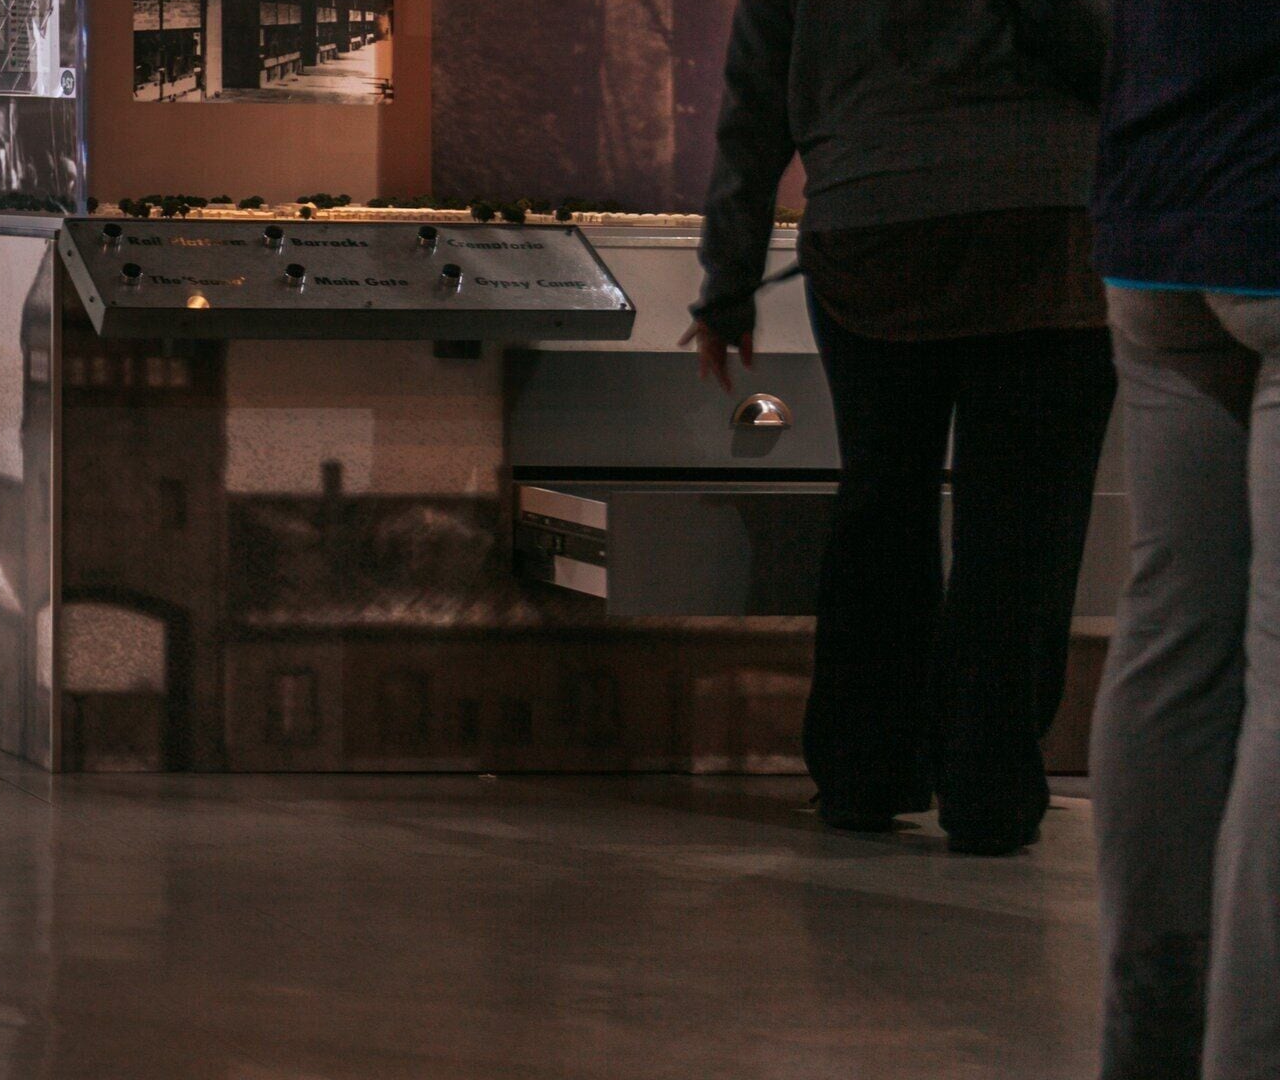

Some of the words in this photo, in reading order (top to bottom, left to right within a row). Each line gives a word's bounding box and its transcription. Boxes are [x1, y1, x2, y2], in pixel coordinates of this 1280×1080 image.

[127, 236, 163, 247] Rail
[291, 237, 369, 248] Barracks
[314, 277, 359, 288] Main
[365, 277, 409, 288] Gate
[474, 276, 531, 289] Gypsy
